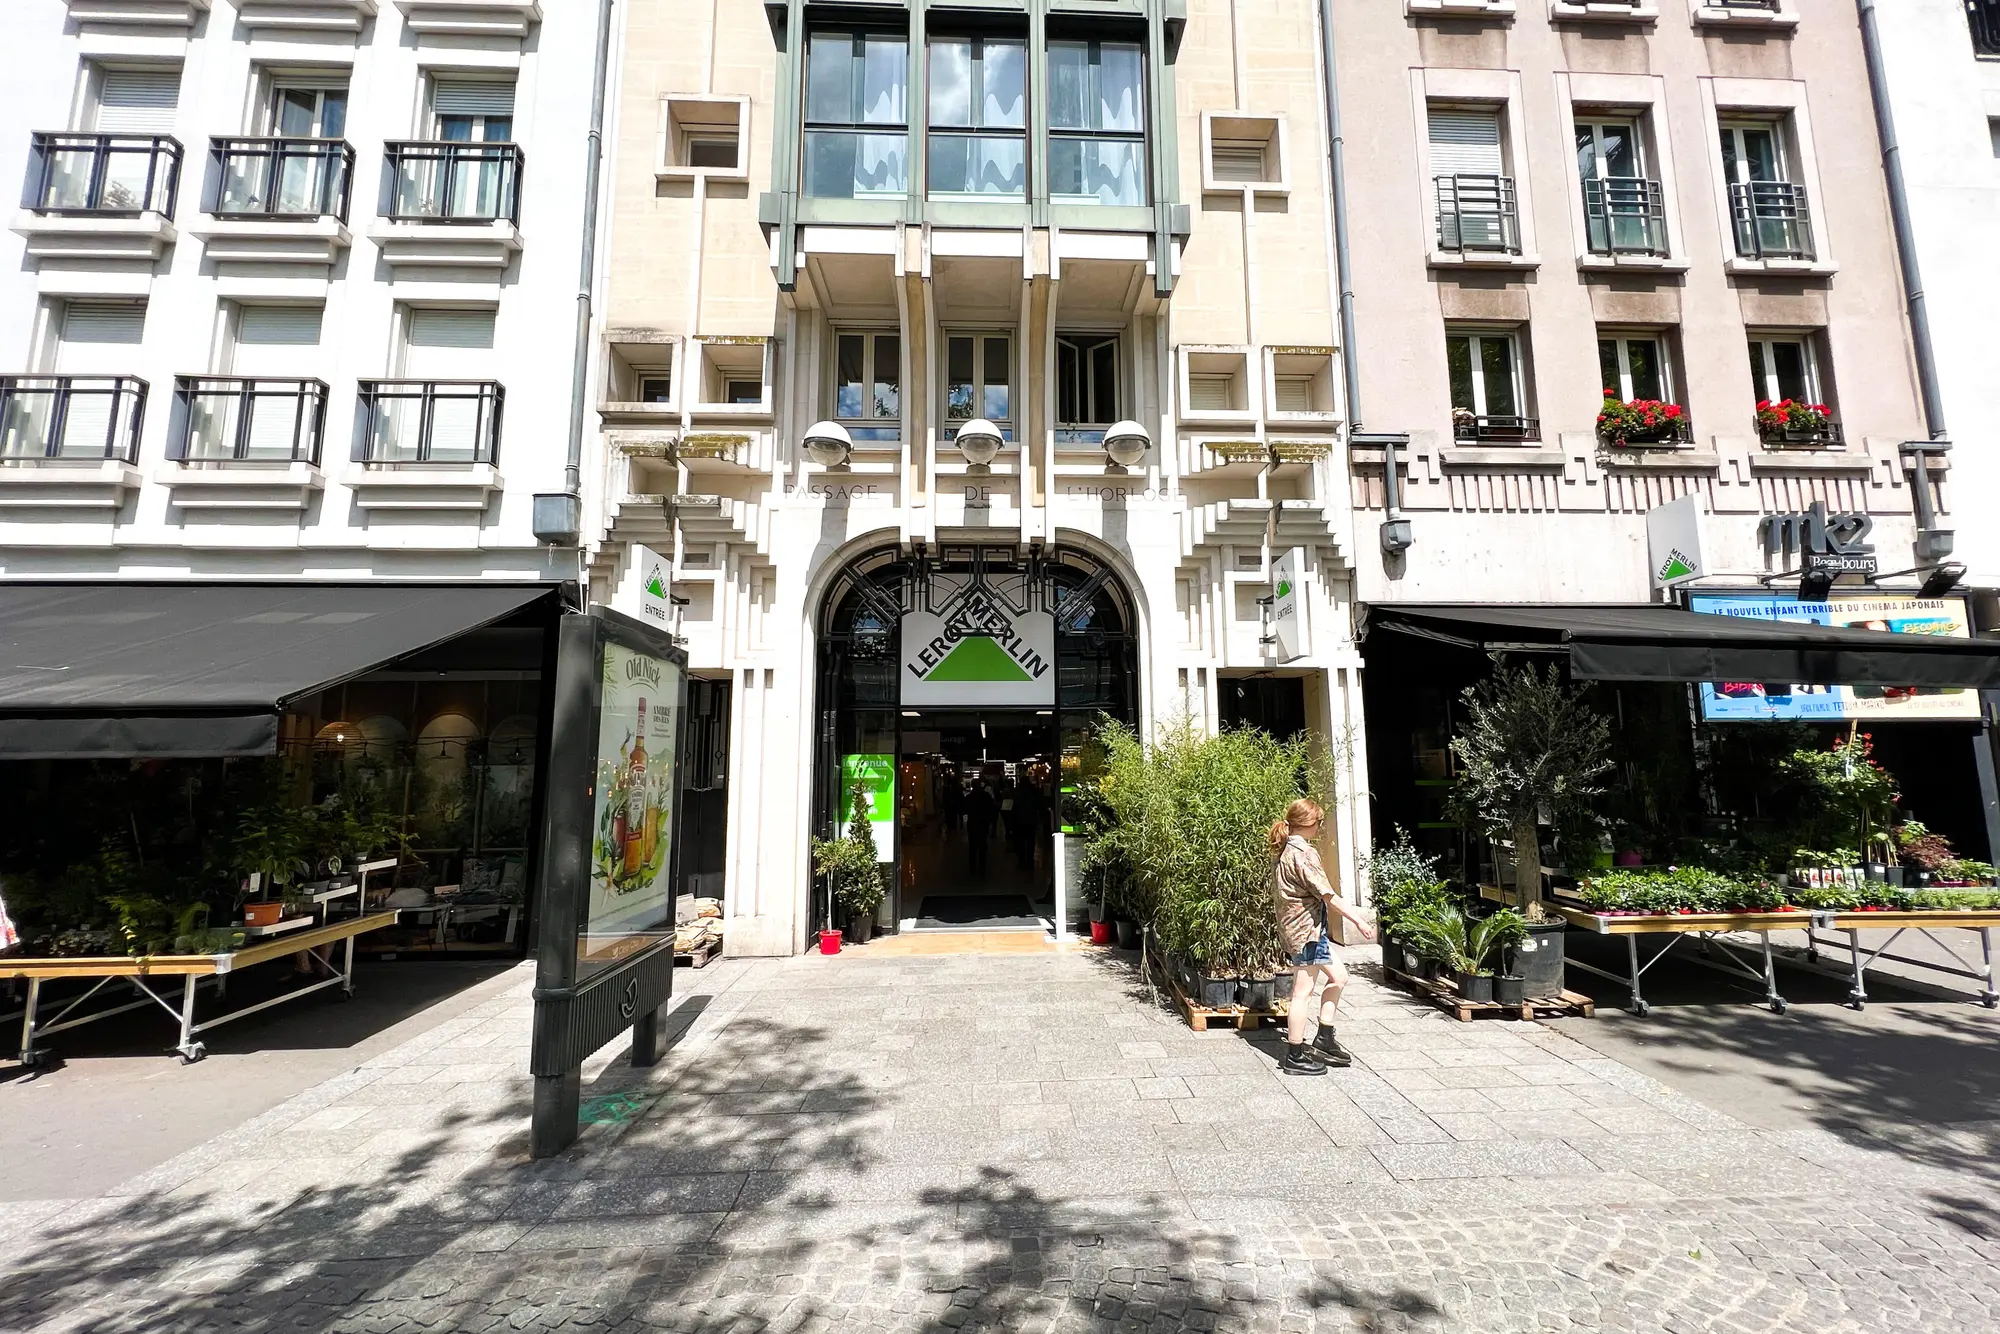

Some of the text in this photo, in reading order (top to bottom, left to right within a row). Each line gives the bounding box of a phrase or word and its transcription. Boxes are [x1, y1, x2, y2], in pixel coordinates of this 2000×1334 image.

[784, 484, 879, 500] PASSAGE
[964, 485, 993, 500] DE
[1757, 501, 1875, 554] mk2
[1657, 548, 1698, 581] LEROY MERLIN
[645, 603, 665, 620] ENTRÉE
[1277, 603, 1293, 620] ENTRÉE
[1727, 607, 1762, 616] NOUVEL
[1765, 605, 1798, 615] ENFANT
[1802, 604, 1843, 614] TERRIBLE
[1847, 603, 1859, 612] DU
[1901, 600, 1945, 610] JAPONAIS
[906, 595, 1050, 679] LEROY MERLIN
[626, 657, 661, 689] Old Nick
